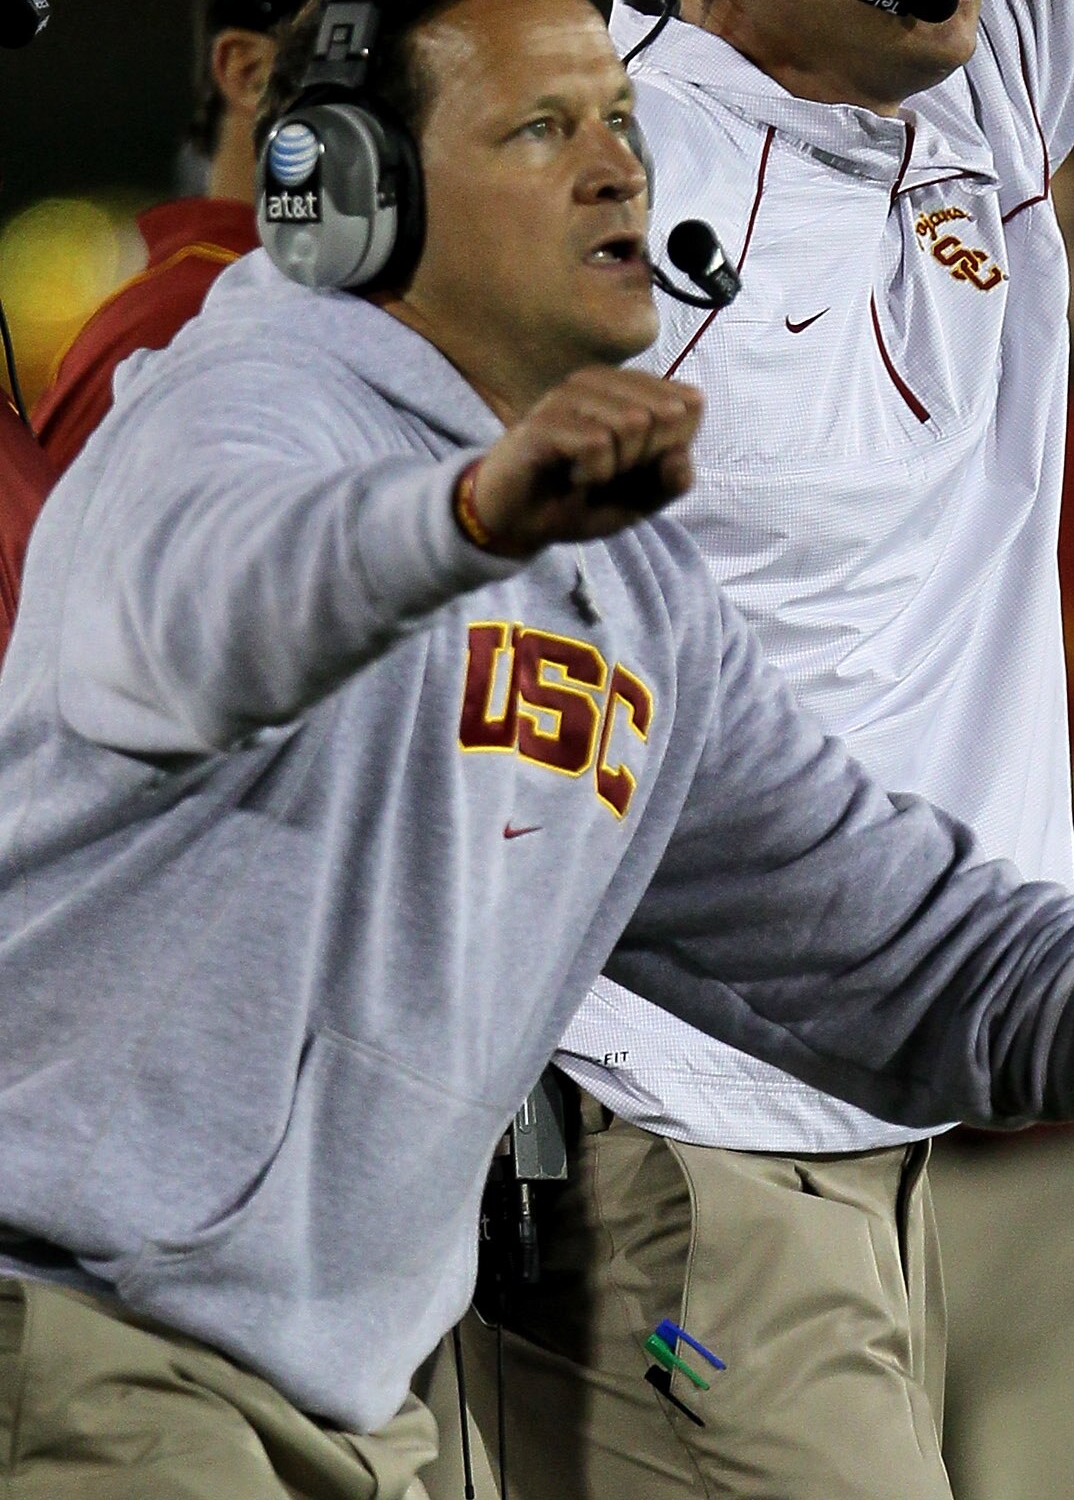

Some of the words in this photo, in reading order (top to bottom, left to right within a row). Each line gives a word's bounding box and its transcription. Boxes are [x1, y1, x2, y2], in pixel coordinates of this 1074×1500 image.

[268, 190, 319, 219] at&t
[931, 234, 1004, 292] SC
[458, 619, 655, 822] USC
